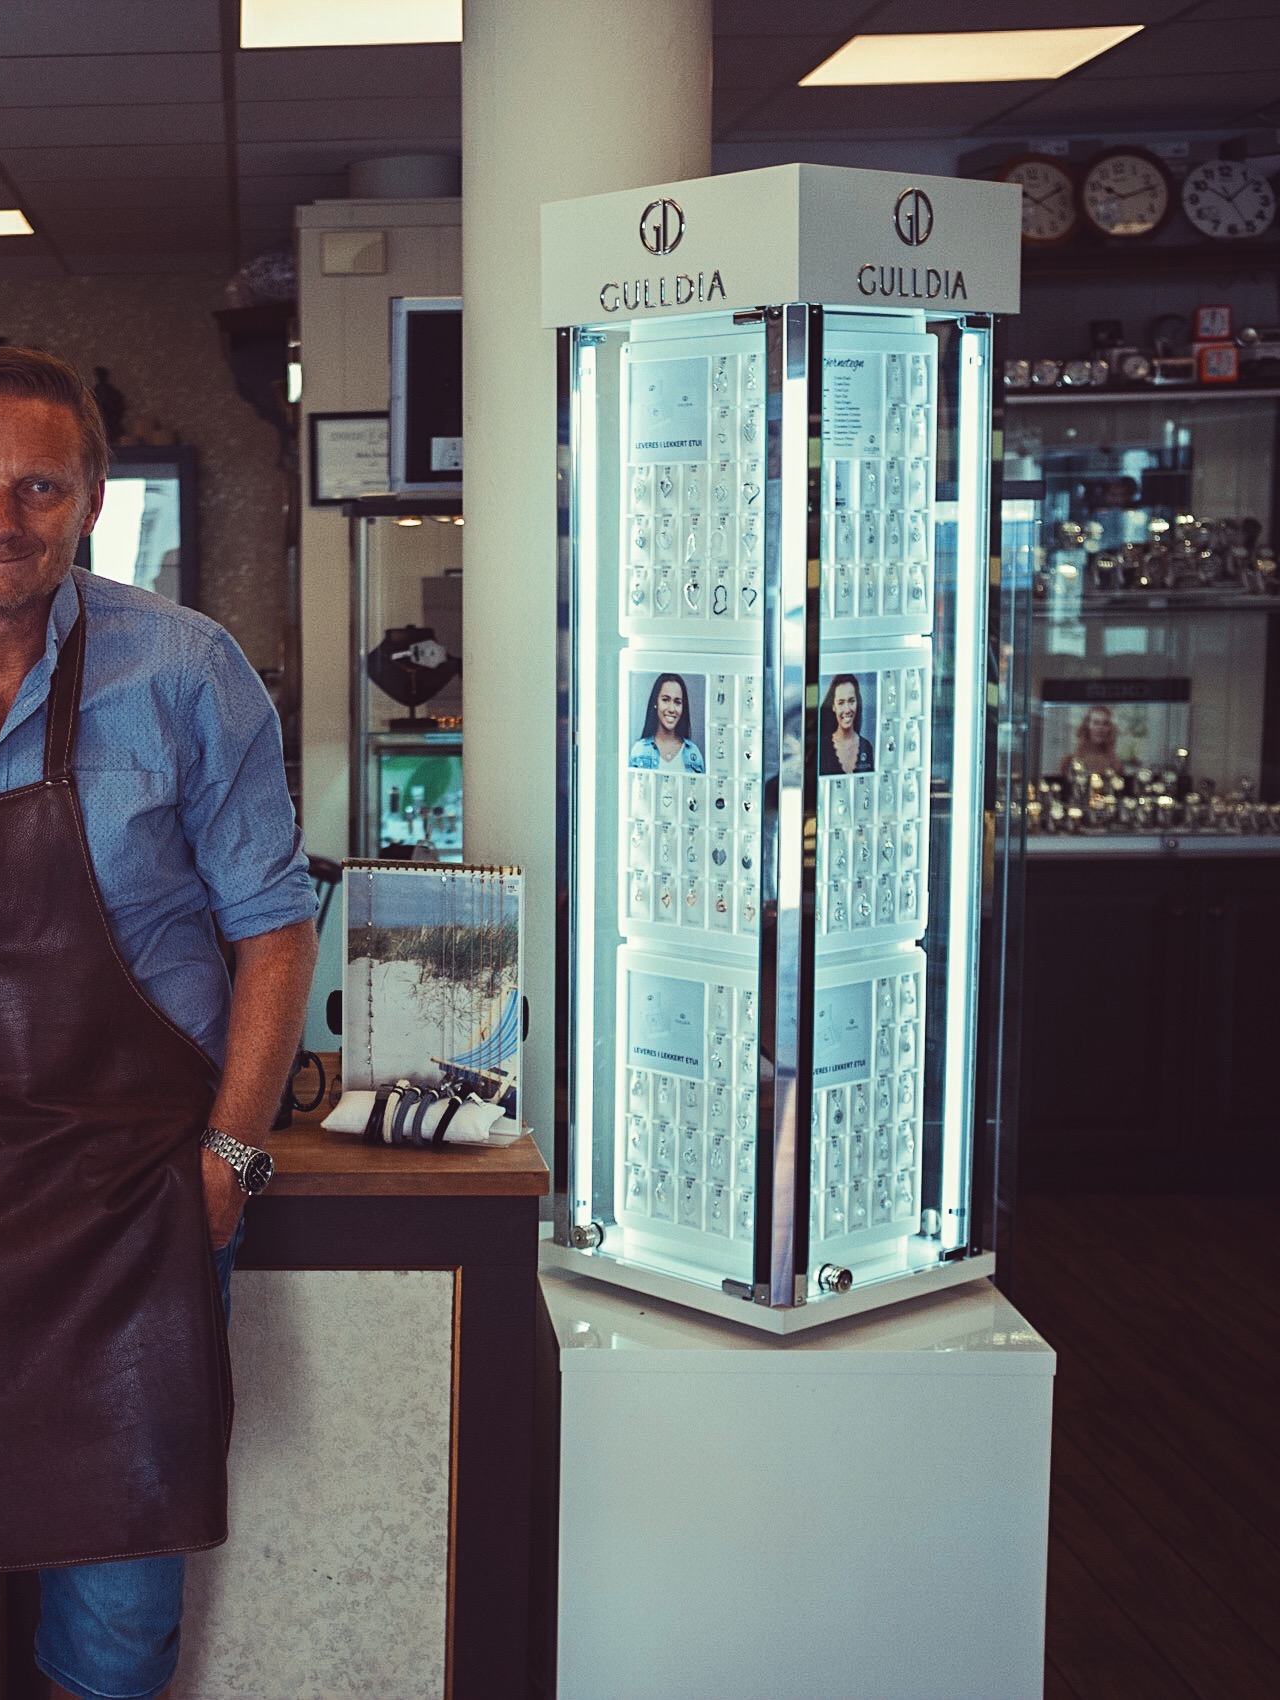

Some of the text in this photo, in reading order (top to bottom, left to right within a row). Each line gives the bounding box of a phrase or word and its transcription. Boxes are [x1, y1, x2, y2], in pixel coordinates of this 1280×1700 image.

[600, 269, 728, 312] GULLDIA
[857, 263, 967, 300] GULLDIA
[635, 441, 659, 449] LEVERES
[633, 1046, 657, 1057] LEVERES
